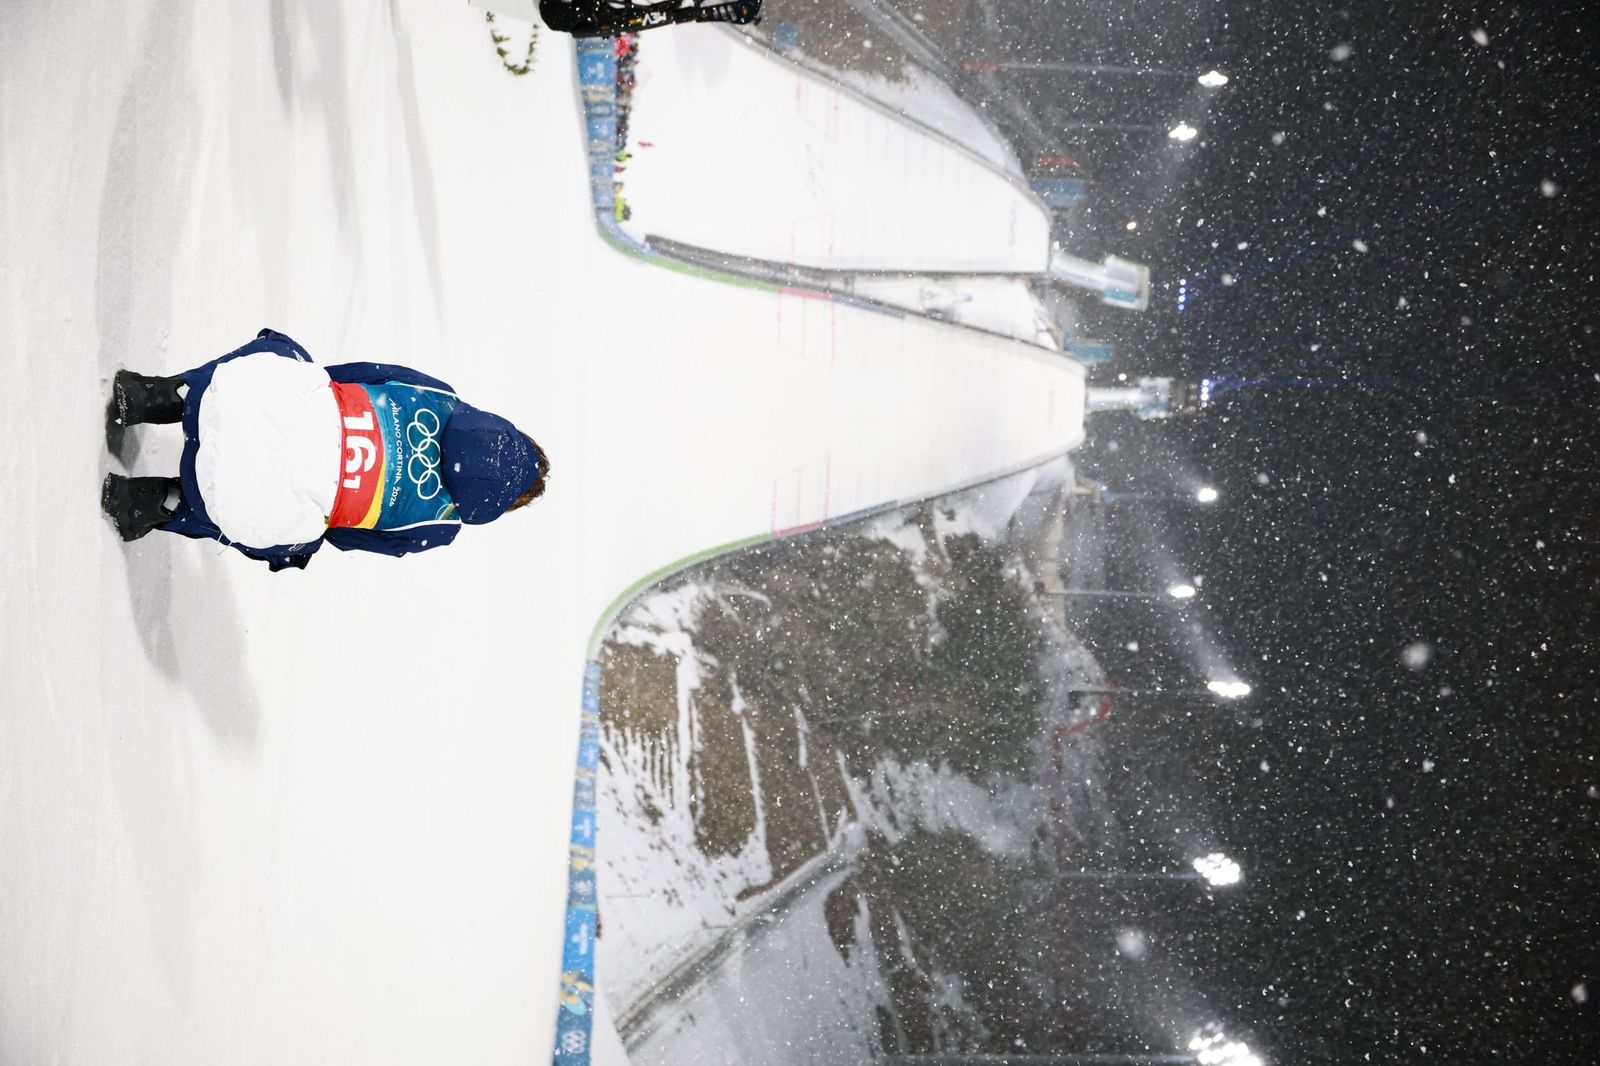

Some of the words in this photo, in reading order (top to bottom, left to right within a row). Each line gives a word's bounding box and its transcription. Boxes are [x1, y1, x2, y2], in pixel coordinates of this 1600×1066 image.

[388, 398, 402, 439] MILANO
[394, 440, 403, 485] CORTINA
[389, 486, 401, 507] 2026
